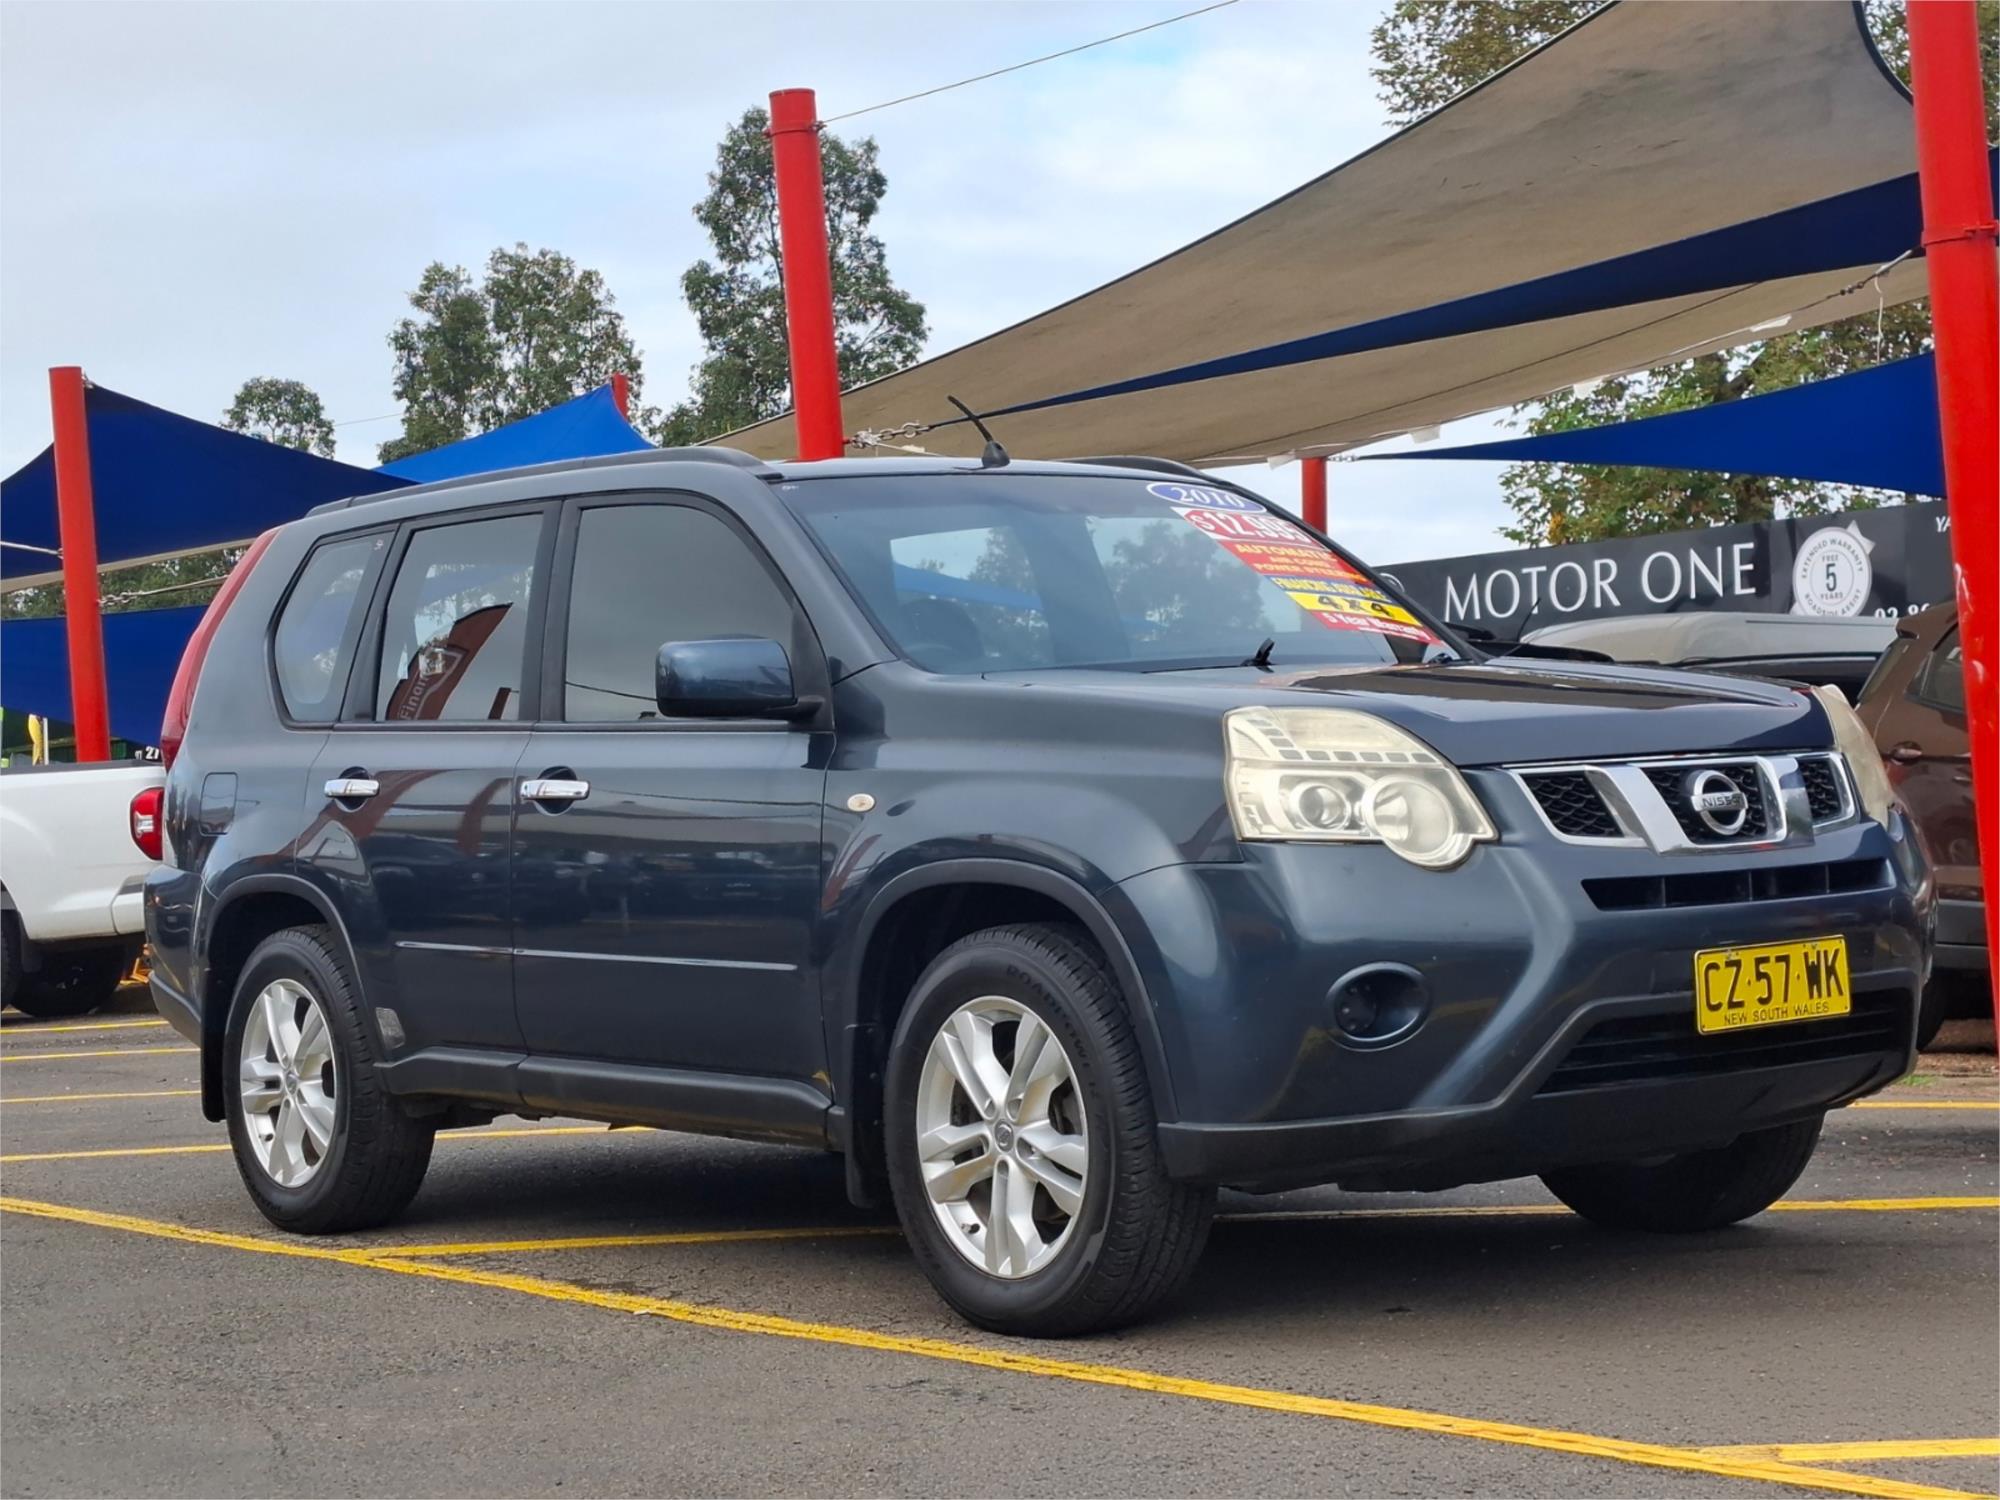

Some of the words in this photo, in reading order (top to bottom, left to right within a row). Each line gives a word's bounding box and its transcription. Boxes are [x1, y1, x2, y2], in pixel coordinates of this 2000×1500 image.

[1170, 487, 1245, 508] 2010
[1802, 539, 1828, 579] EXTENDED
[1830, 538, 1864, 572] WARRANTY
[1444, 558, 1621, 622] MOTOR
[1640, 542, 1756, 603] ONE
[1825, 563, 1837, 592] 5
[1820, 592, 1843, 601] YEARS
[1724, 1013, 1748, 1026] NEW
[1753, 1007, 1788, 1022] SOUTH
[1794, 1001, 1830, 1016] WALES
